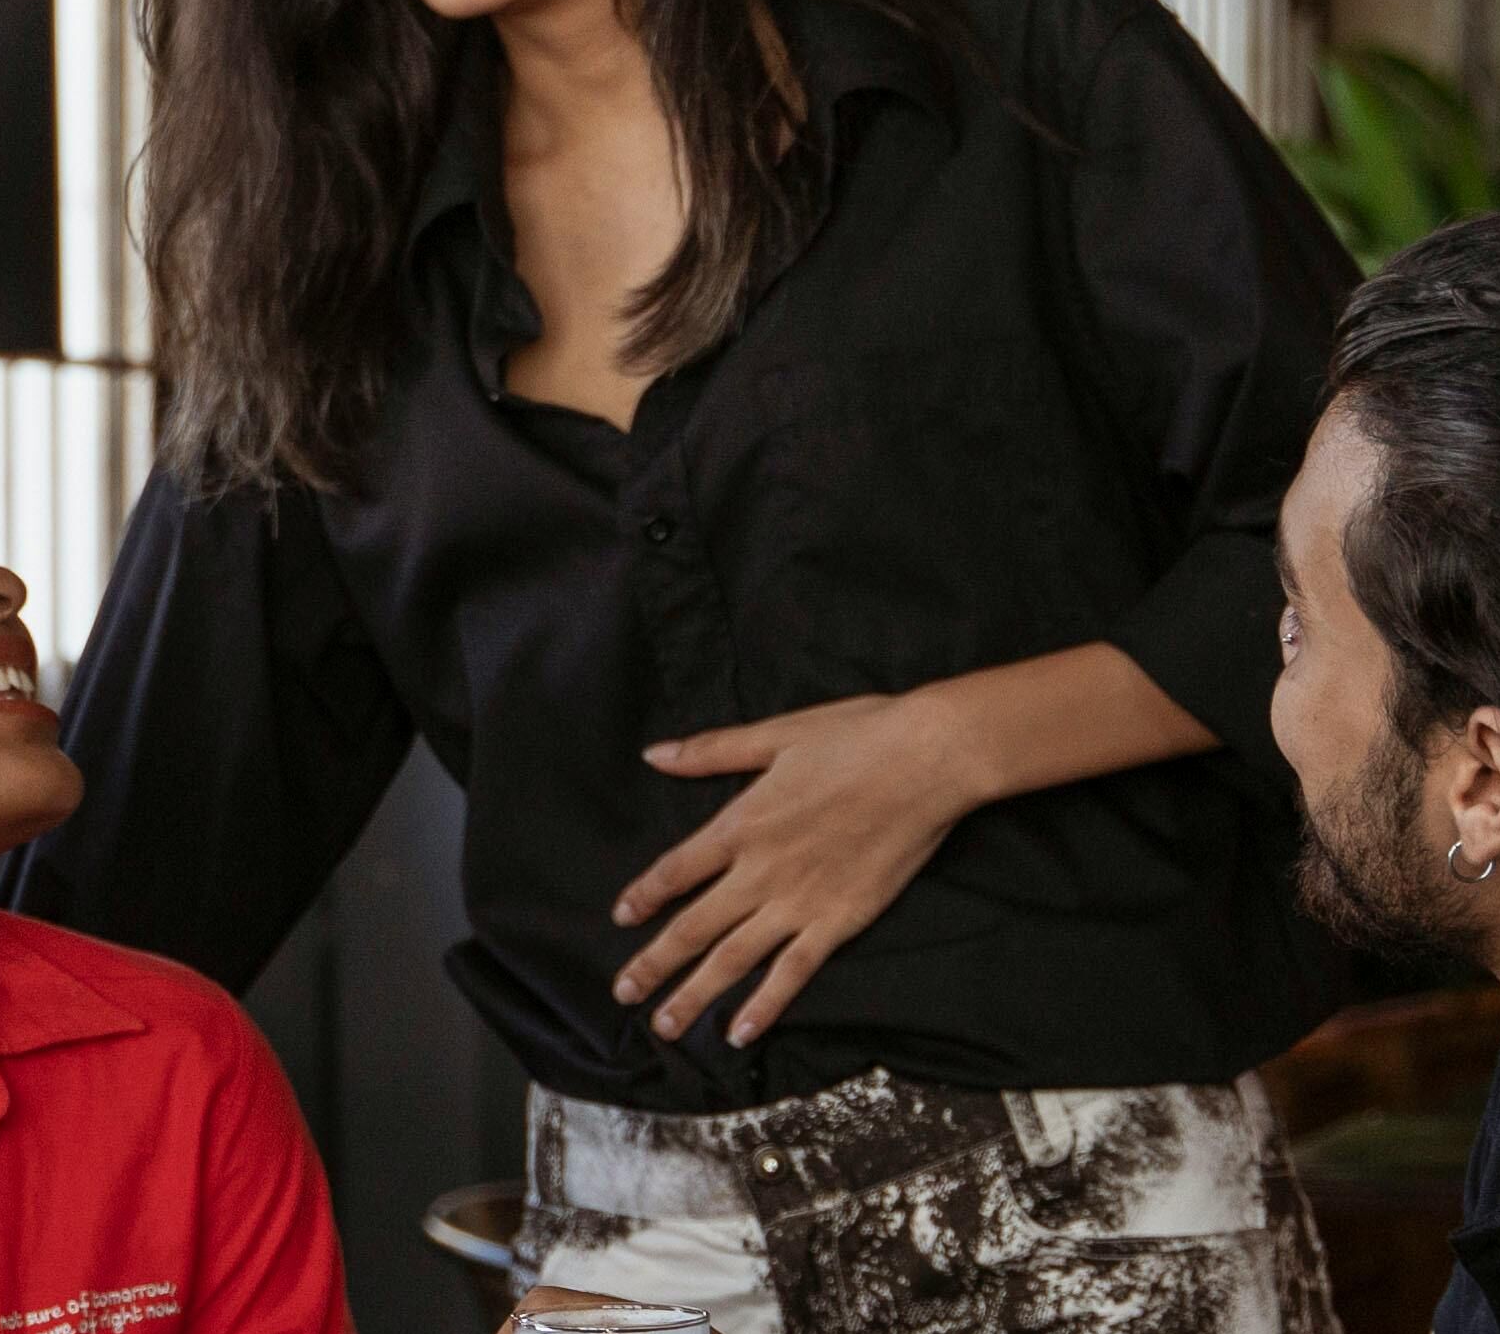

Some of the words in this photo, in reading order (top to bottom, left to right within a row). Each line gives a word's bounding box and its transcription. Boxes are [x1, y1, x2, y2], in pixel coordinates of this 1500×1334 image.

[0, 1310, 23, 1330] not
[25, 1306, 65, 1327] sure
[66, 1290, 89, 1317] of
[100, 1304, 143, 1334] right
